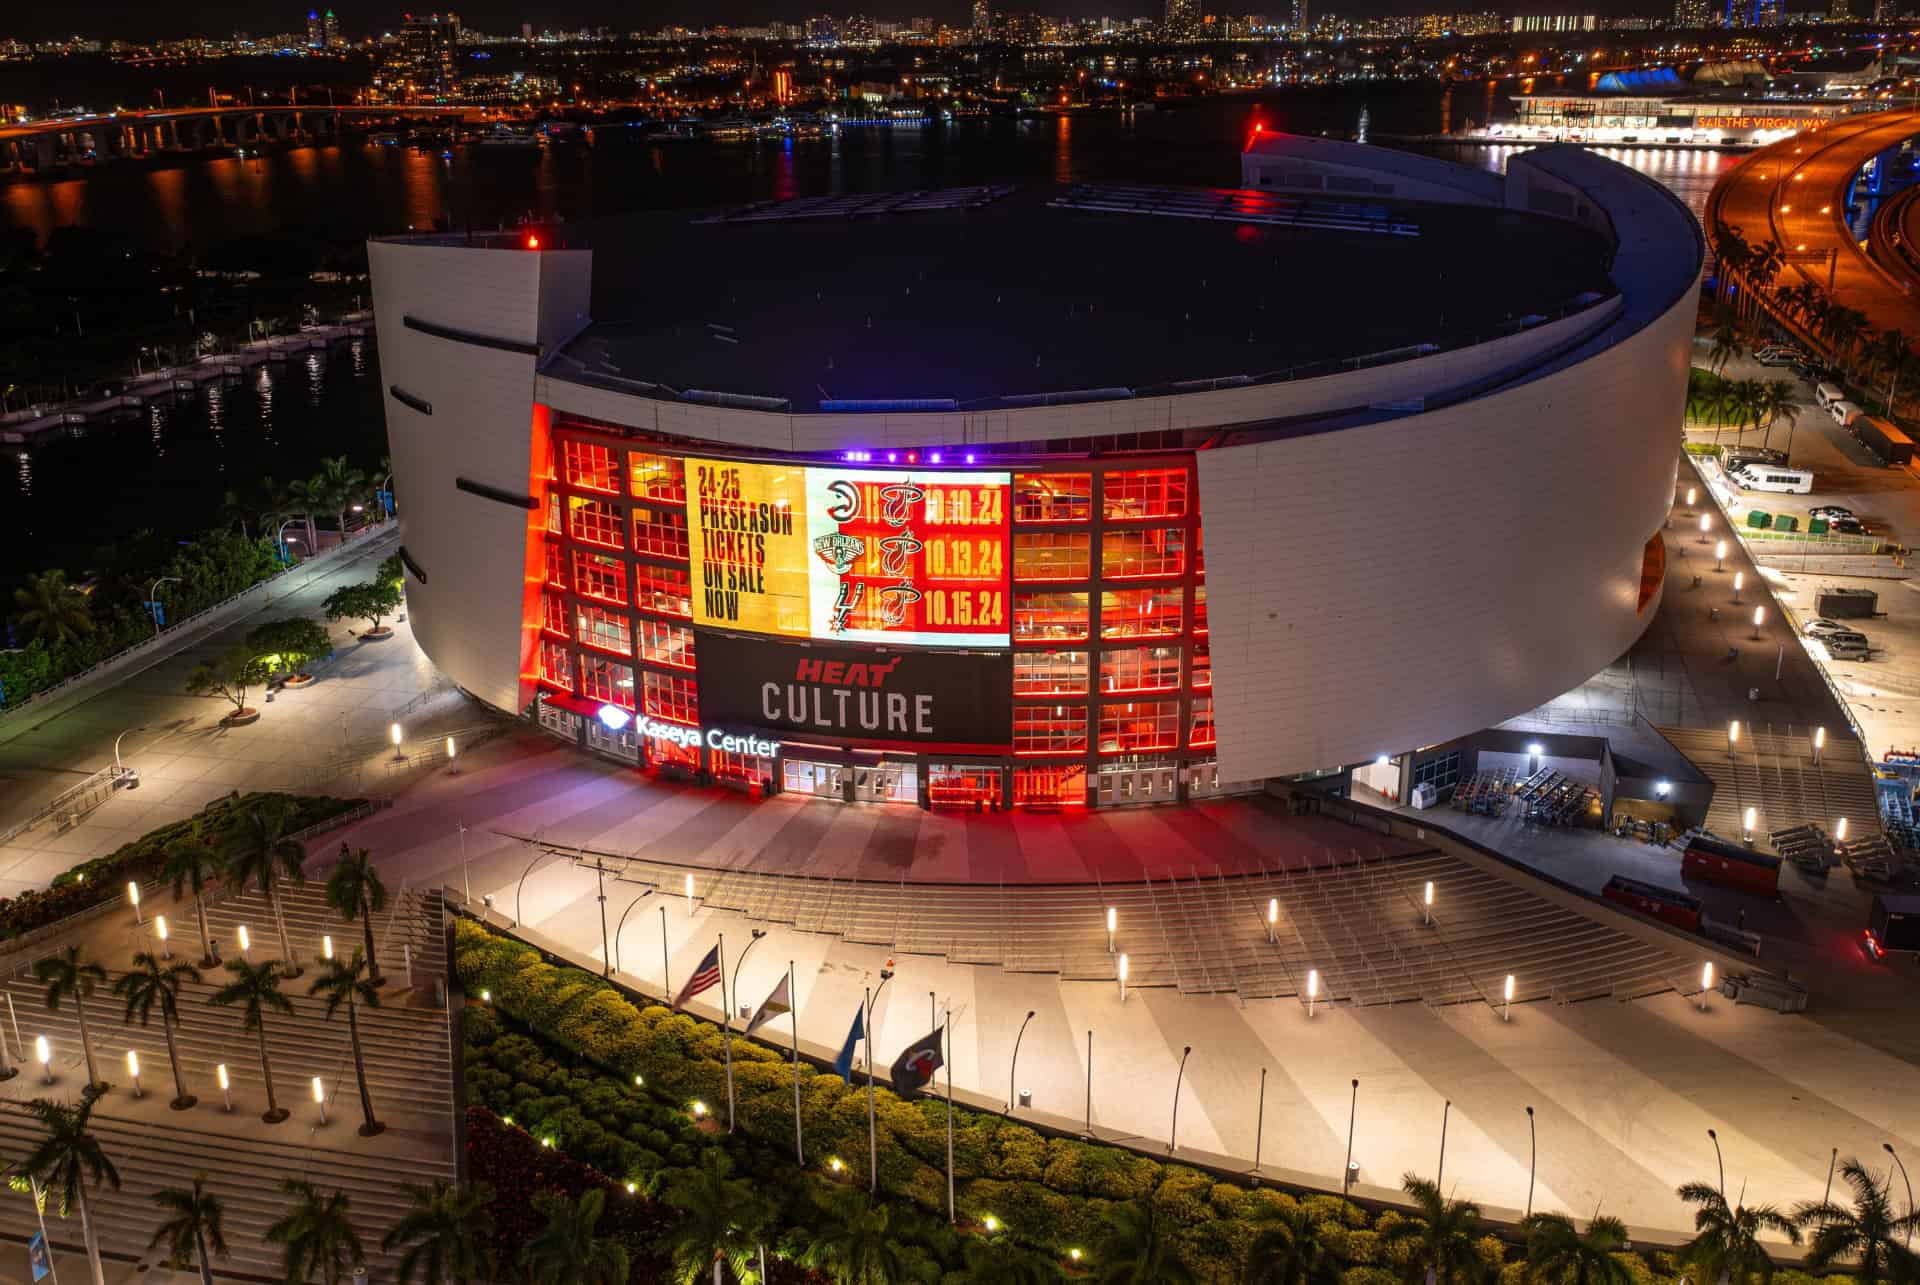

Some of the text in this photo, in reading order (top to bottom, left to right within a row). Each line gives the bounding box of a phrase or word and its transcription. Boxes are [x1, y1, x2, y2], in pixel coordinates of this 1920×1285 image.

[1698, 117, 1725, 128] SAIL
[1726, 118, 1750, 128] THE
[1802, 119, 1829, 129] WAY
[700, 498, 793, 536] PRESEASON
[924, 489, 1003, 526] 10.10.24
[702, 527, 765, 566] TICKETS
[924, 540, 1003, 576] 10.13.24
[703, 559, 765, 594] ON SALE
[705, 588, 738, 621] NOW
[924, 590, 1003, 626] 10.15.24
[796, 656, 902, 687] HEAT
[762, 682, 933, 734] CULTURE
[635, 714, 781, 758] Kaseya Center
